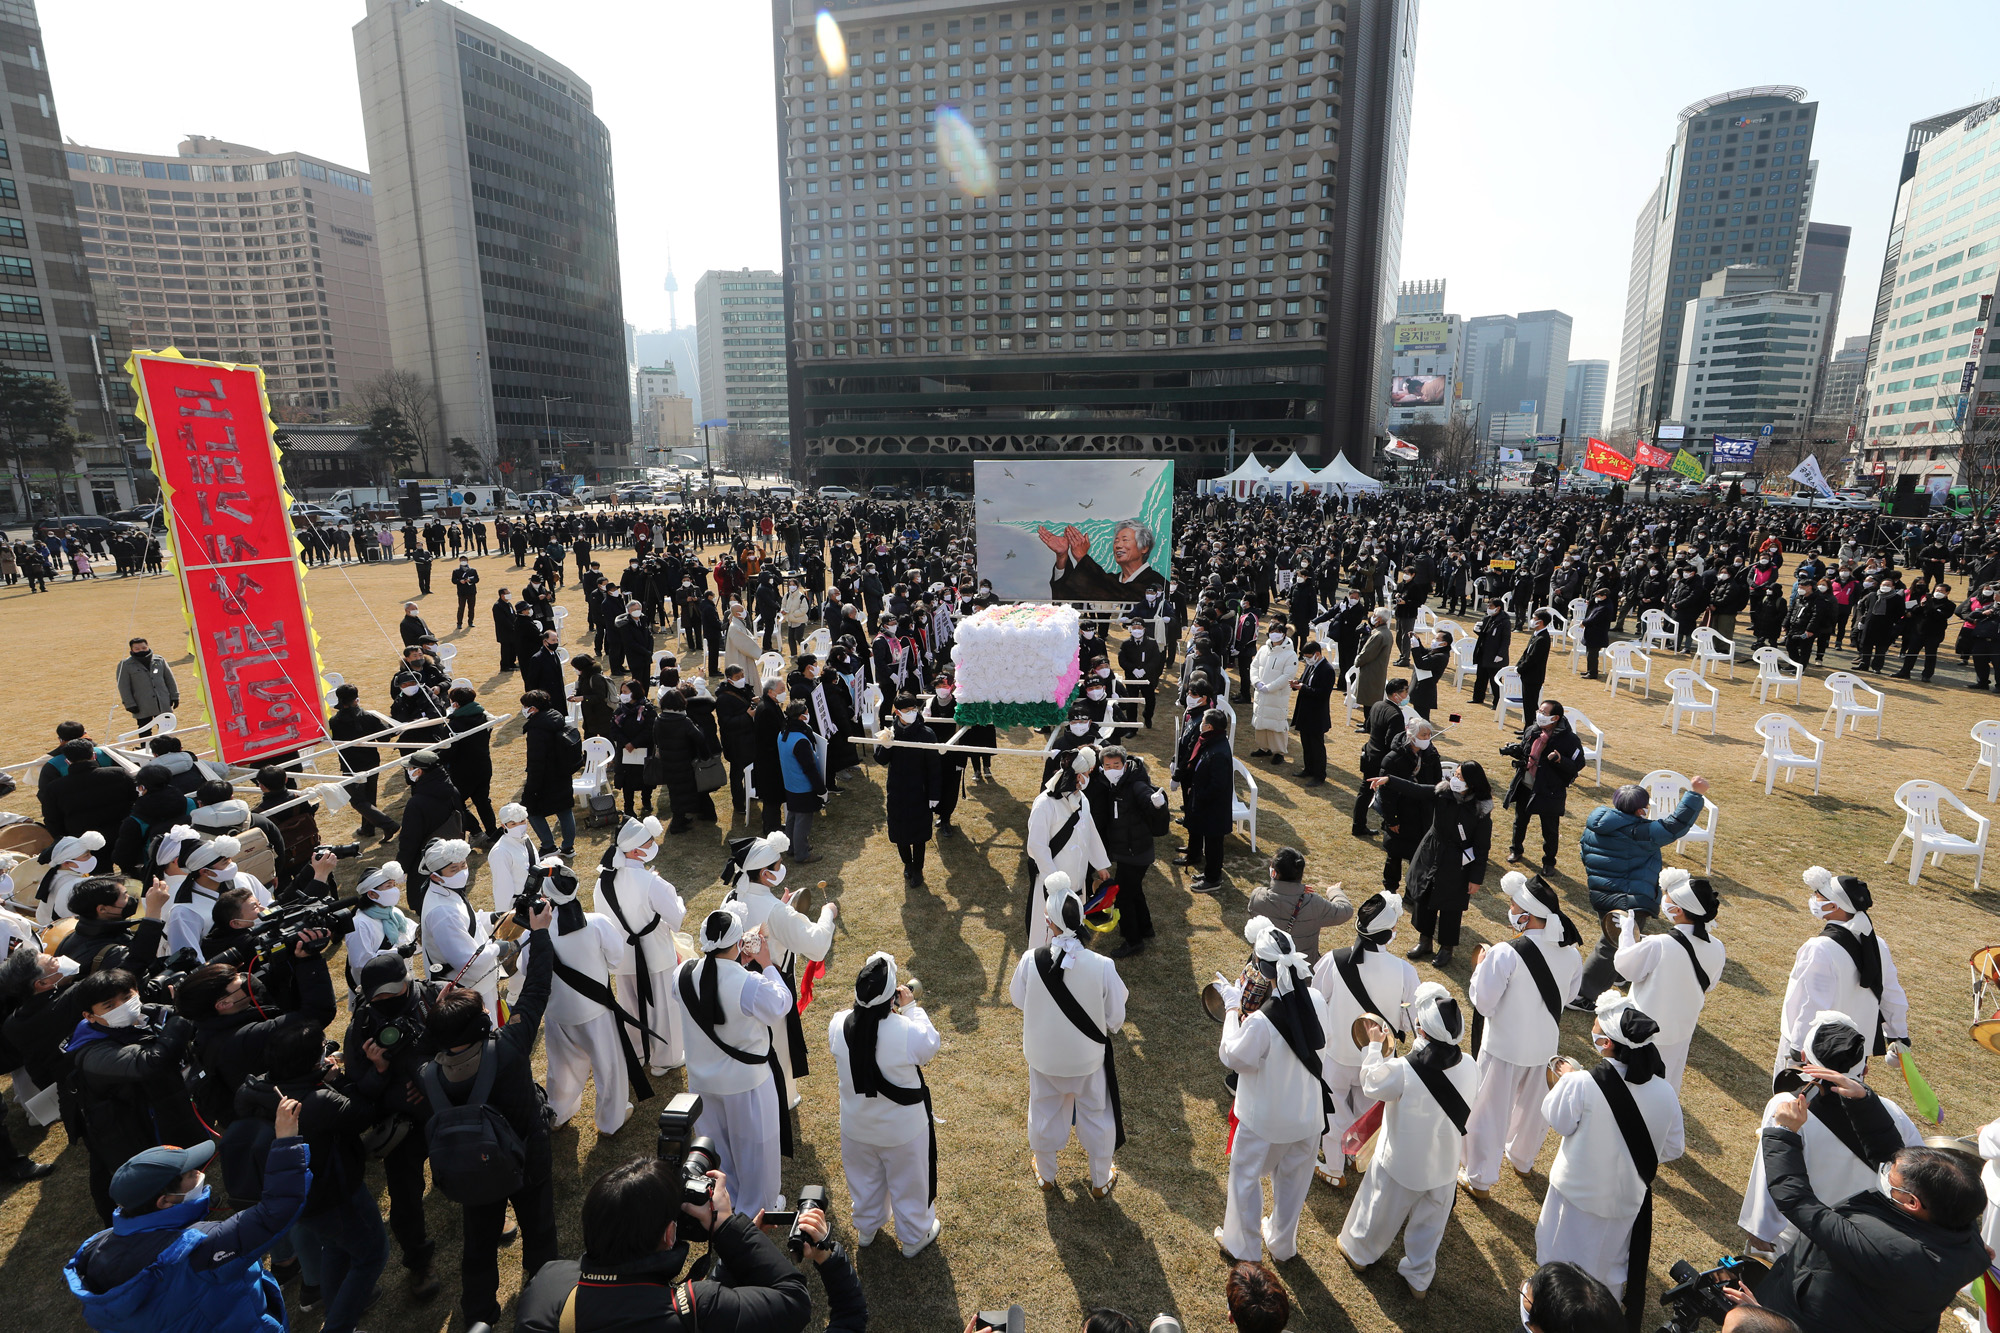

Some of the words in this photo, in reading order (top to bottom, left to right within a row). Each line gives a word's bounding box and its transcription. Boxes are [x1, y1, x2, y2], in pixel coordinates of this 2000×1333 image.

[1399, 331, 1424, 343] 을지
[1715, 438, 1755, 456] 금속노조
[1587, 449, 1633, 471] 노동해방
